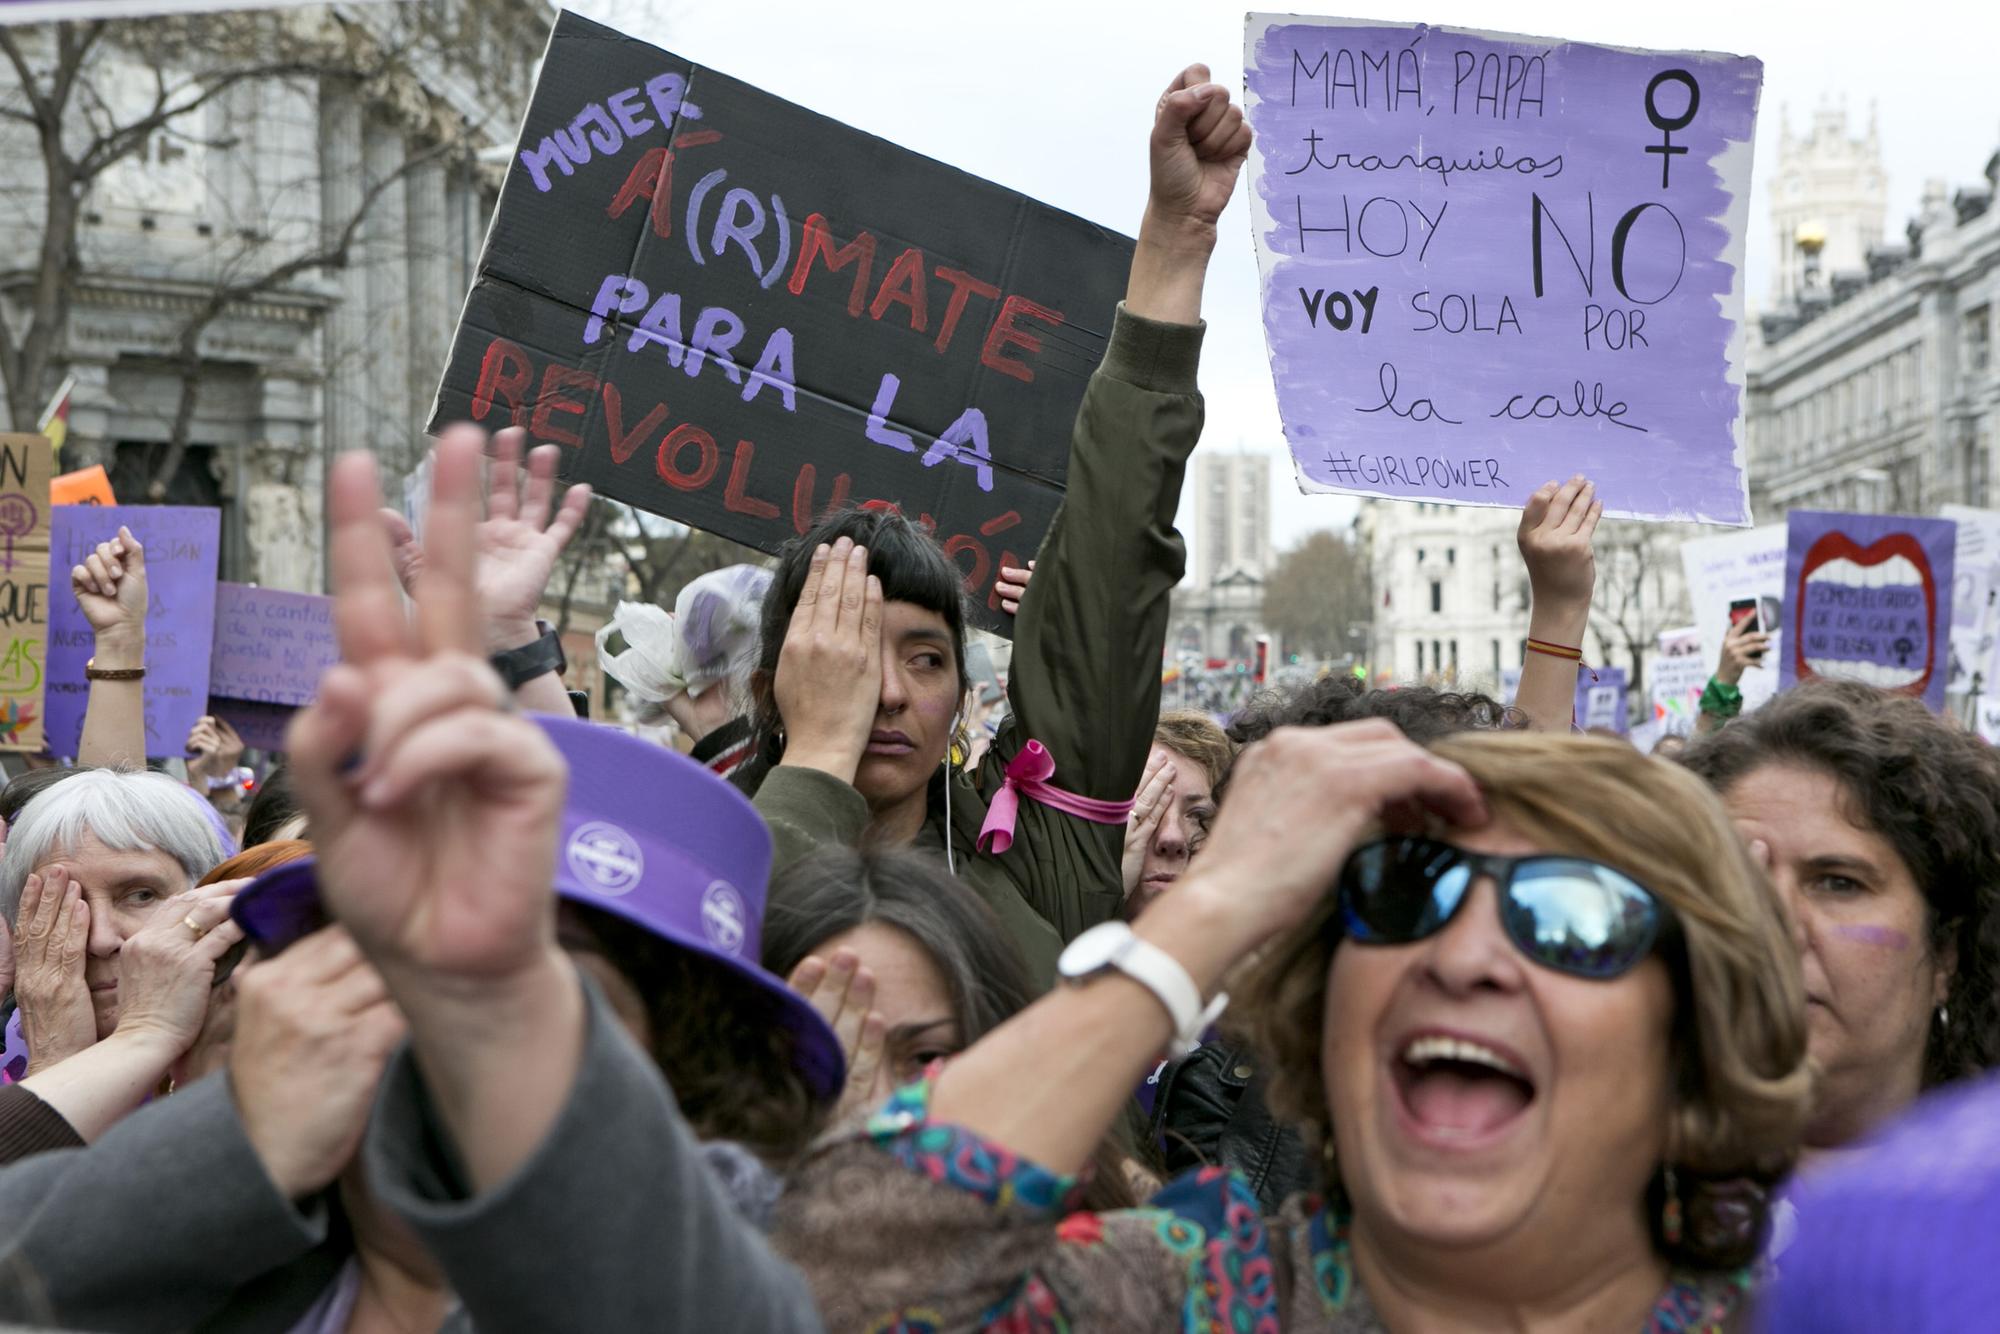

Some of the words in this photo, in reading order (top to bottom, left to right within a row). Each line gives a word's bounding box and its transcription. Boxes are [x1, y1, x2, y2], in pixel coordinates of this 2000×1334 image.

[1291, 36, 1435, 117] MAMÁ,
[1453, 50, 1550, 120] PAPÁ
[519, 72, 703, 192] MUJER
[1285, 129, 1563, 186] tranquilos
[607, 130, 1064, 382] Á(R)MATE
[1297, 194, 1448, 262] HOY
[1532, 191, 1685, 305] NO
[1298, 285, 1379, 334] VOY
[1411, 291, 1522, 335] SOLA
[1583, 304, 1649, 350] POR
[582, 274, 797, 413] PARA
[865, 372, 994, 492] LA
[1354, 362, 1463, 424] la
[1489, 380, 1648, 432] calle
[1323, 451, 1510, 488] #GIRLPOWER
[265, 602, 334, 624] cantid
